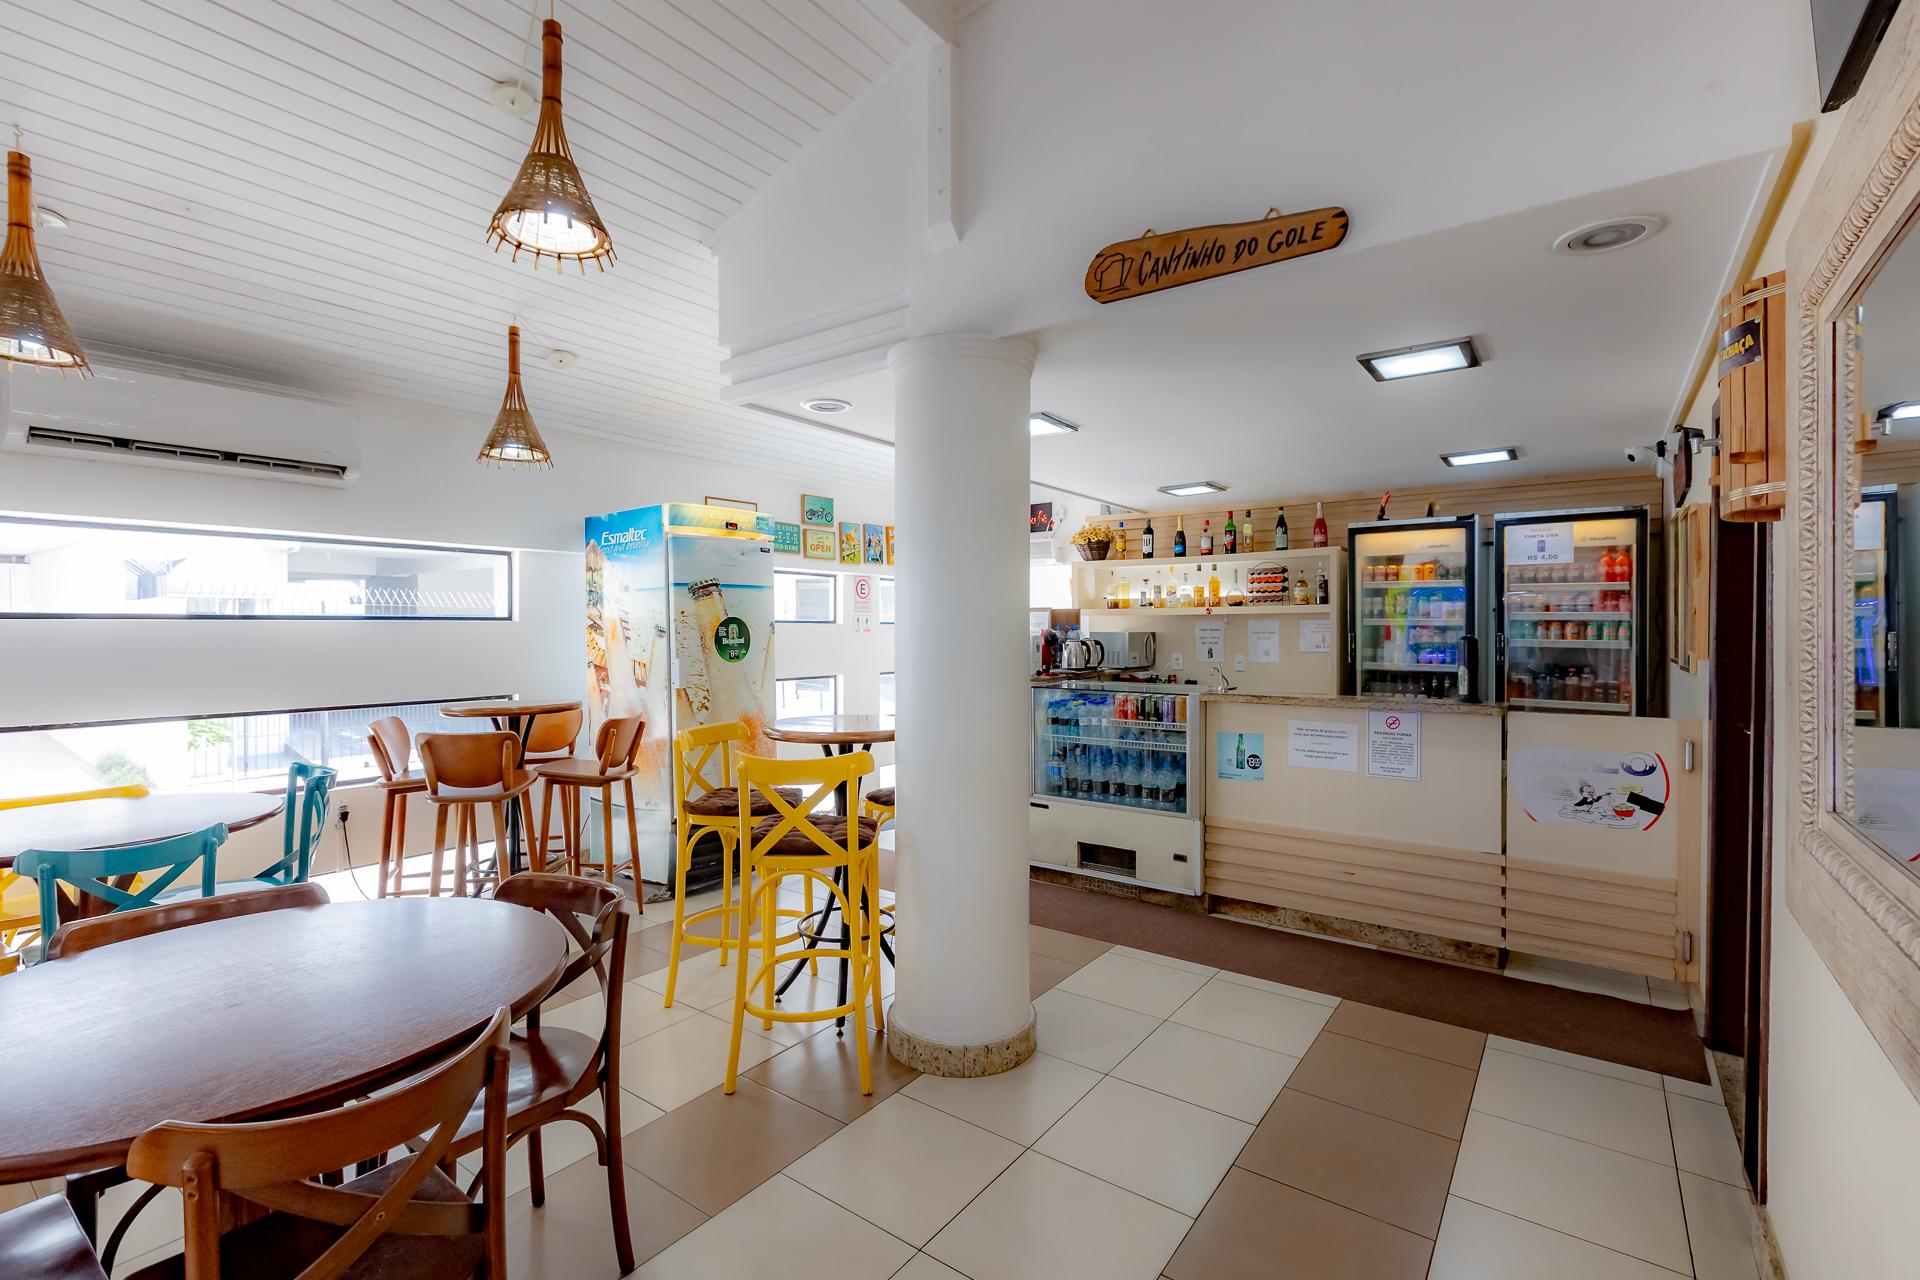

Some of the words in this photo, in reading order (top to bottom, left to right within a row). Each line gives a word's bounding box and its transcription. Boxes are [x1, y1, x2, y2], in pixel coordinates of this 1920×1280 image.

[1138, 237, 1226, 287] CANTINHO
[1232, 237, 1259, 264] DO
[1267, 220, 1329, 255] GOLE
[601, 527, 648, 546] Esmaltec
[810, 543, 832, 553] OPEN
[860, 583, 866, 595] E
